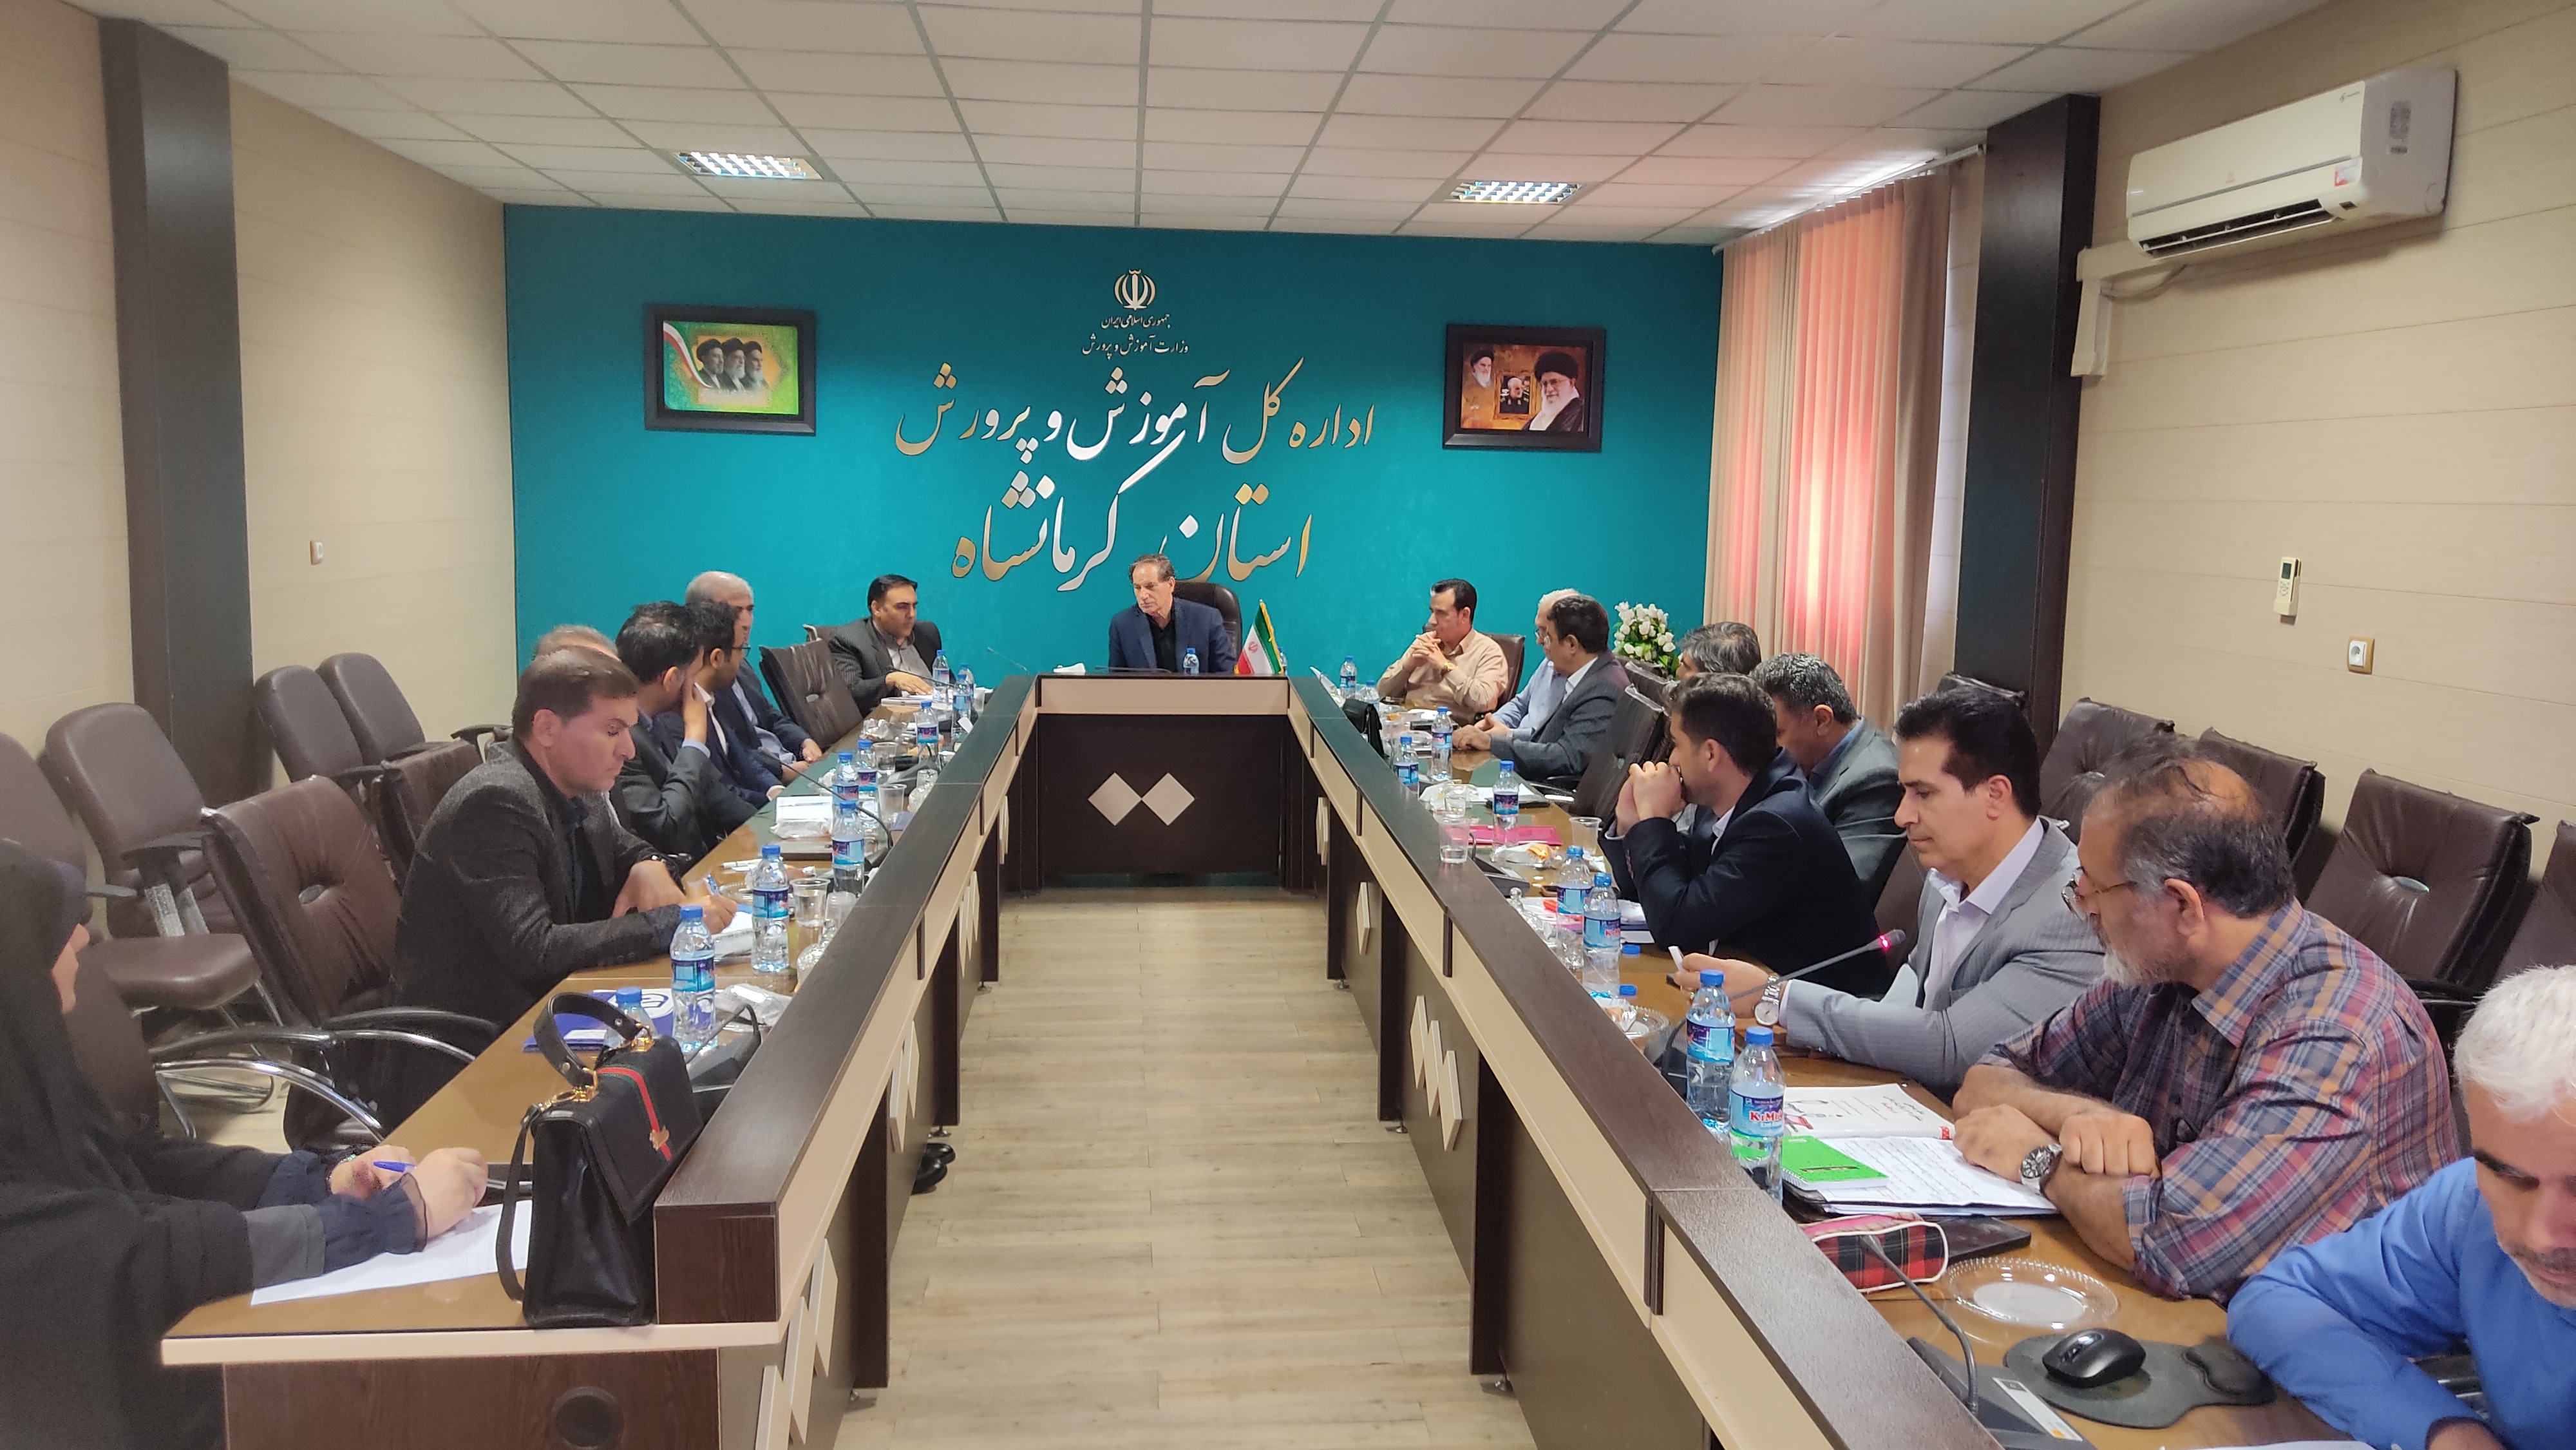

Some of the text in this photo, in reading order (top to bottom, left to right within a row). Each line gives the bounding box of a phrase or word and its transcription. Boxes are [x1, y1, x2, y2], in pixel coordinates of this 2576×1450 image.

[1081, 332, 1189, 361] وزارت آموزش و پرورش
[1101, 313, 1171, 329] جمهوری اسلامی ایران
[895, 357, 1375, 464] اداره کل آموزش و پرورش
[951, 428, 1312, 592] استان کرمانشاه
